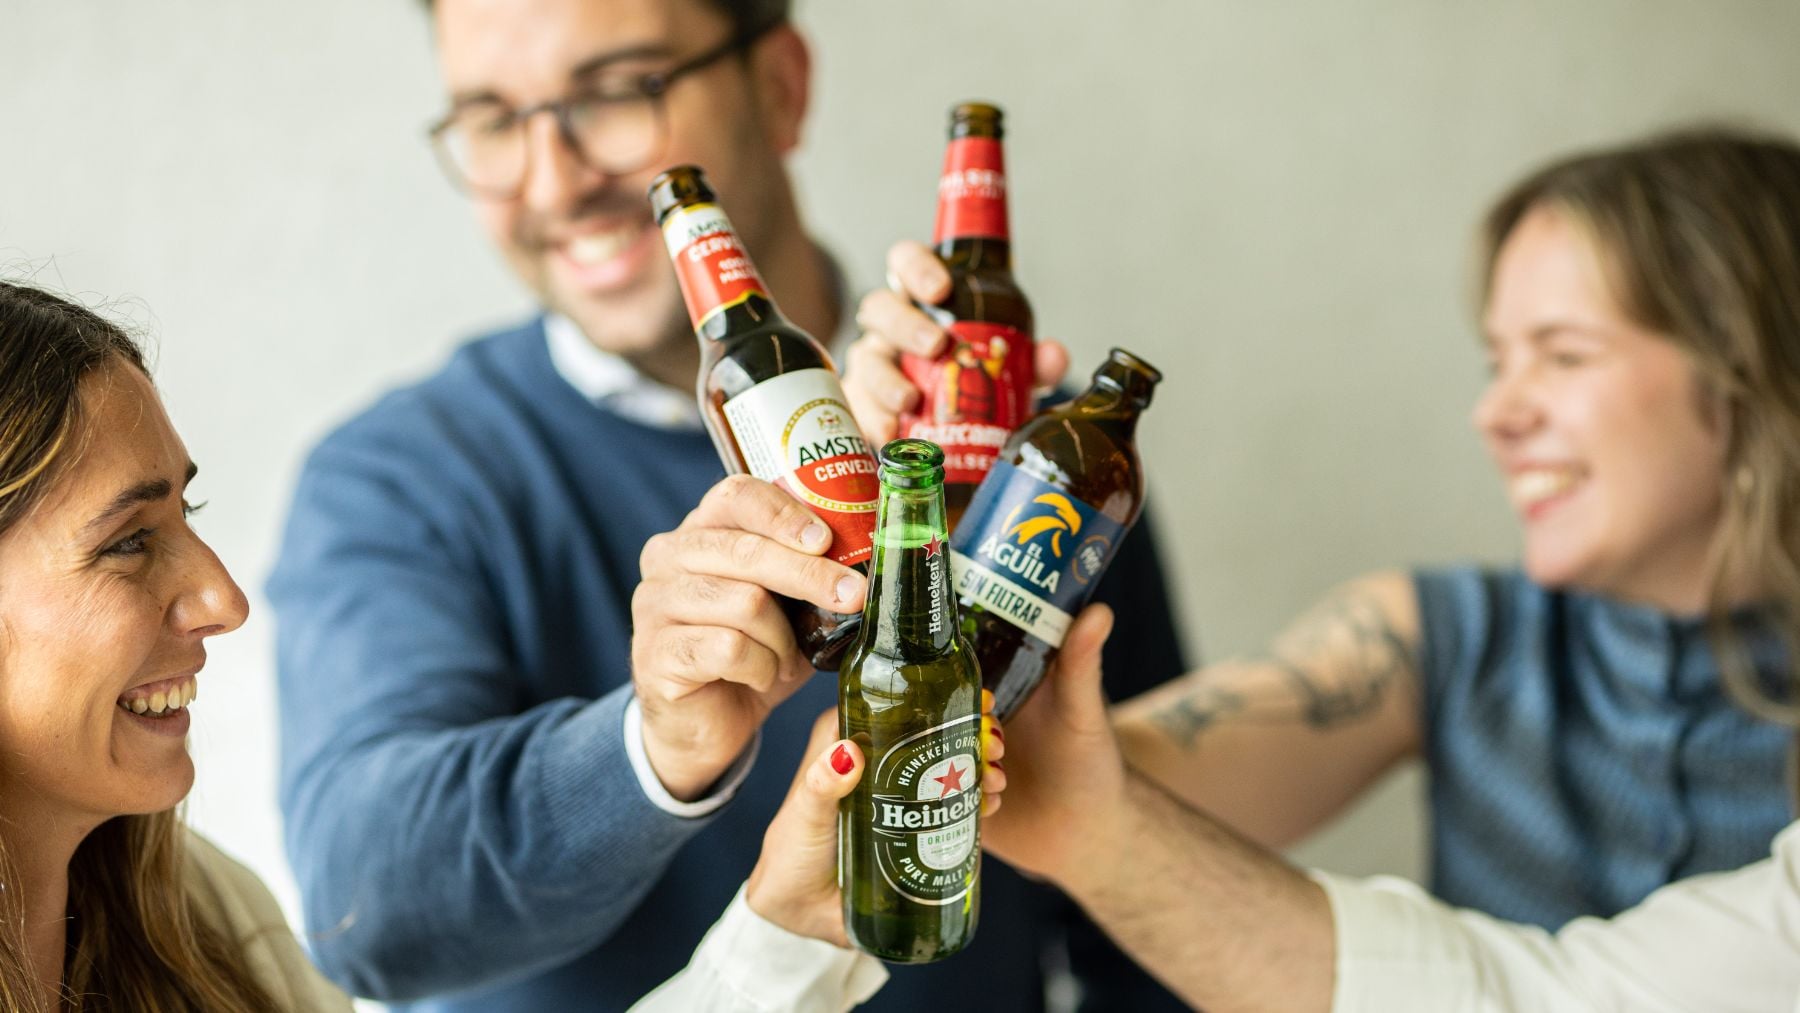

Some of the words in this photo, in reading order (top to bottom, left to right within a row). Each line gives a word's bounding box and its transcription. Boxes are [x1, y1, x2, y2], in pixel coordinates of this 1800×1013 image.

[1027, 542, 1043, 560] EL
[927, 561, 942, 635] Heineken
[960, 568, 988, 597] SIN
[986, 583, 1043, 628] FILTRAR
[897, 742, 951, 787] HEINEKEN
[927, 824, 970, 845] ORIGINAL
[899, 857, 929, 884] PURE
[932, 869, 963, 887] MALT
